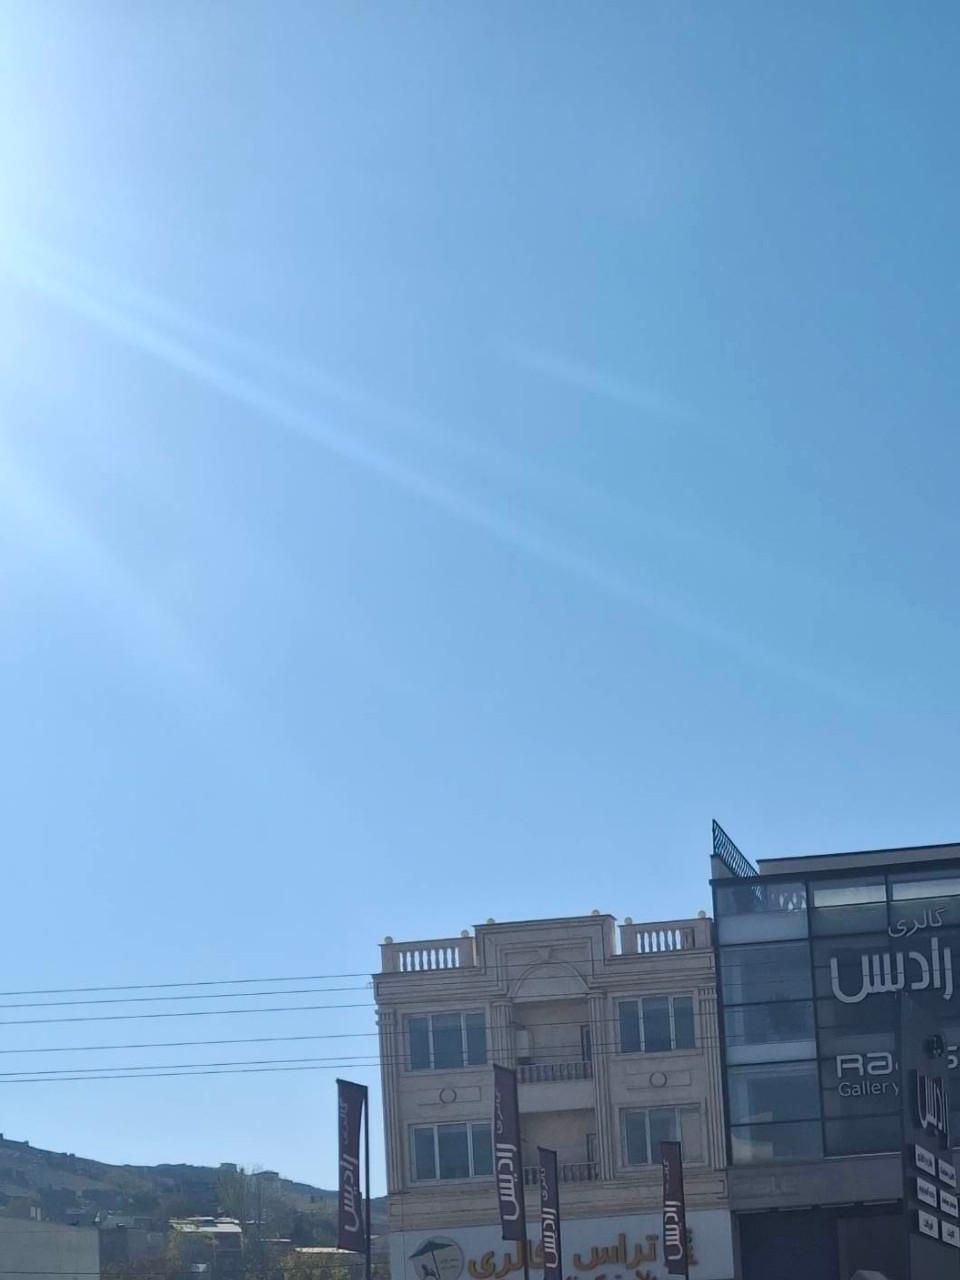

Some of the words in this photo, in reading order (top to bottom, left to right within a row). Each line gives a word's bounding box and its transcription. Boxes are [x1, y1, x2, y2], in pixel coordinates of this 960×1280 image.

[888, 906, 946, 937] گالری
[830, 937, 953, 1003] رادیس
[838, 1081, 899, 1097] Gallery
[496, 1143, 520, 1221] رادیس
[541, 1207, 559, 1268] رادیس
[573, 1233, 659, 1271] تراس
[663, 1201, 684, 1260] رادیس
